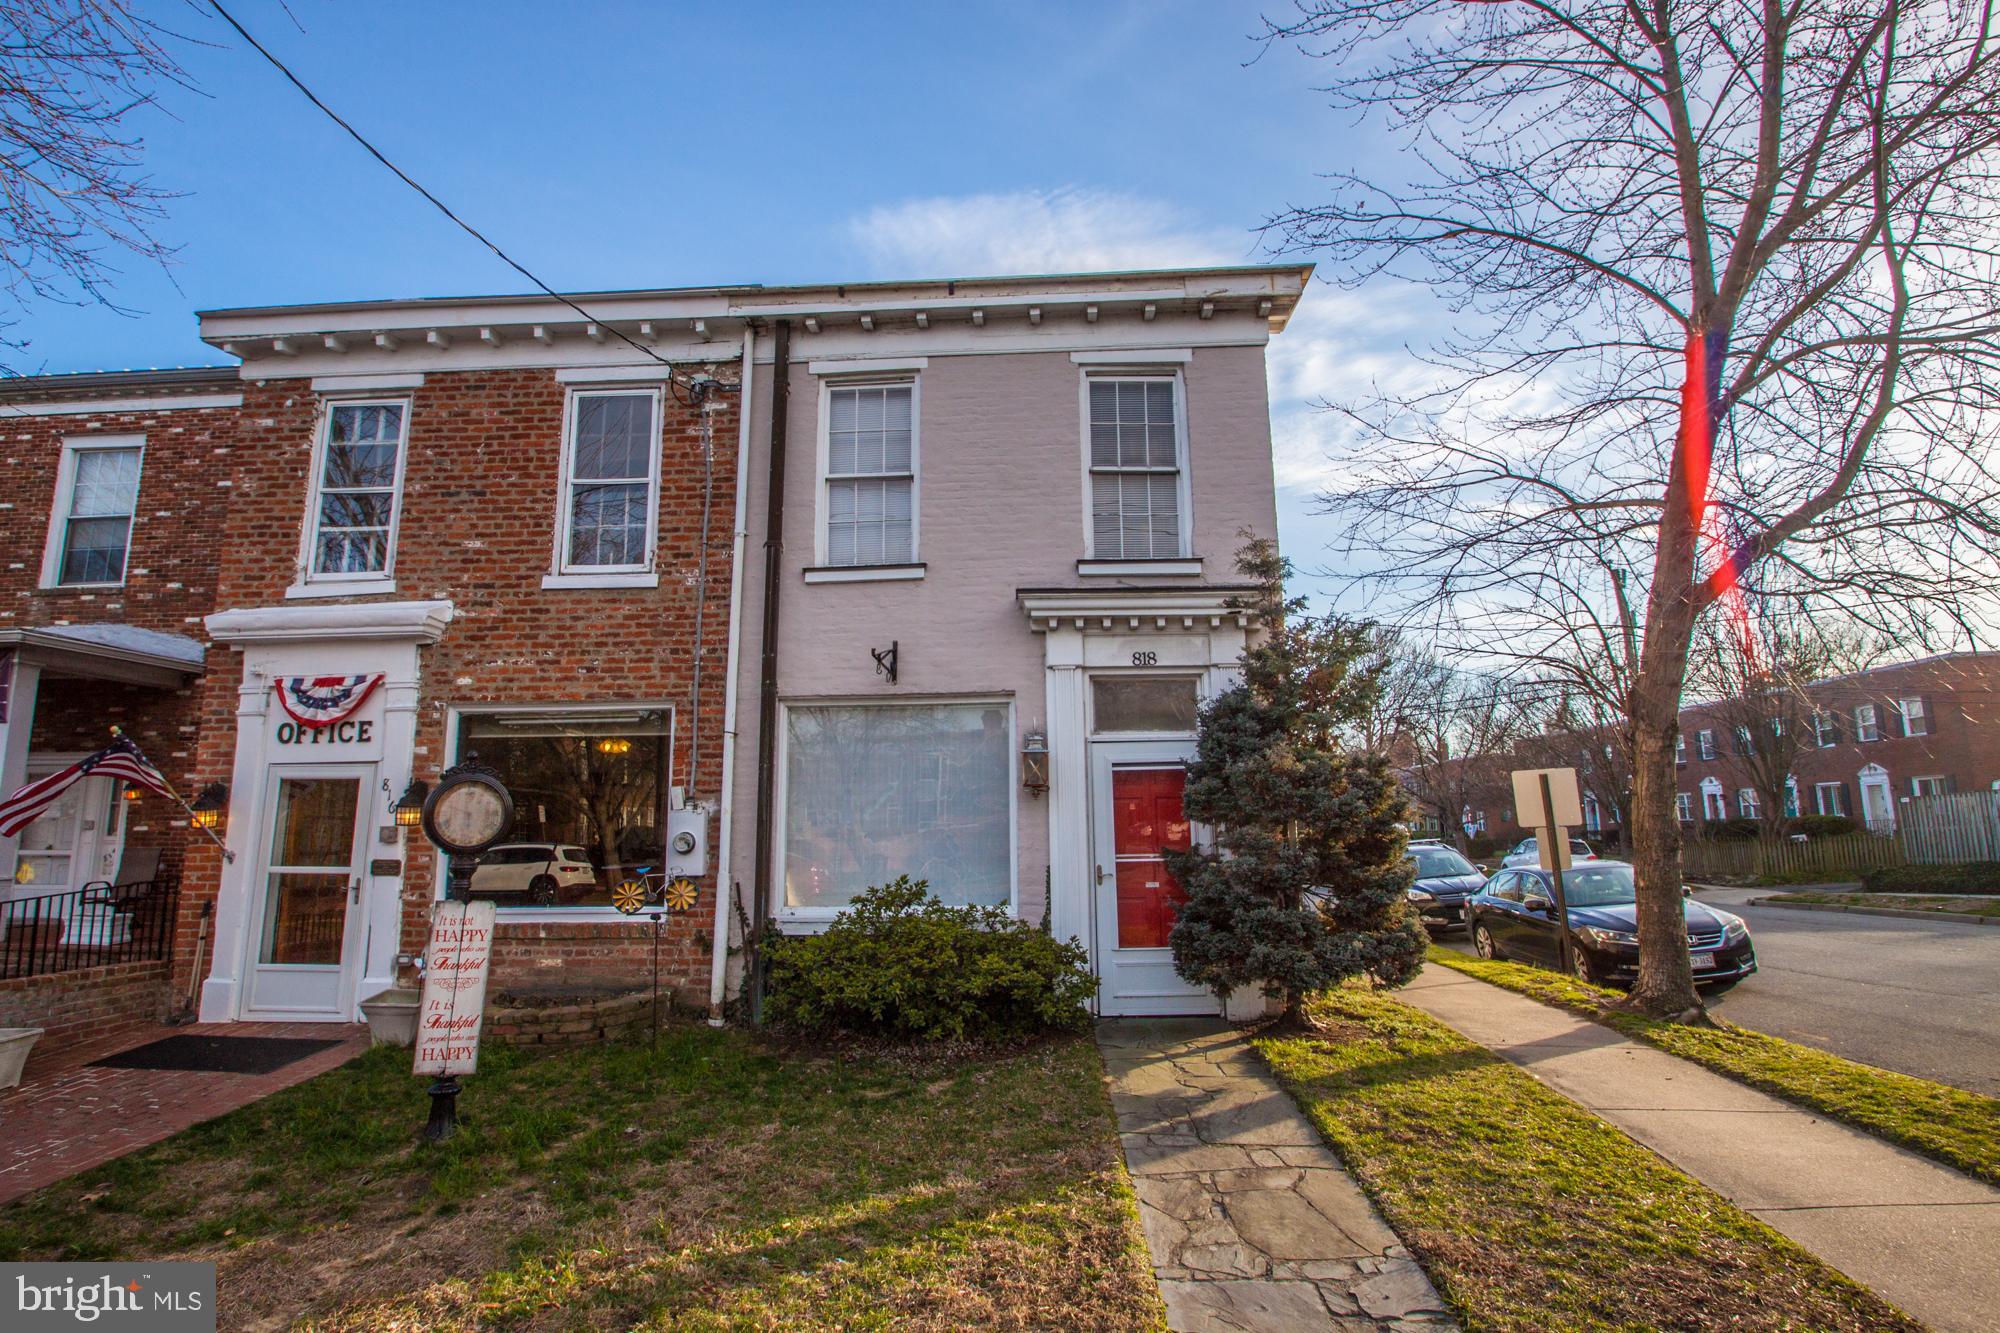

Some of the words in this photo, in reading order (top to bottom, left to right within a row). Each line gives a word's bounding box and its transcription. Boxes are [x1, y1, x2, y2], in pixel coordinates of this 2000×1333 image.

[1132, 651, 1157, 666] 818
[277, 721, 373, 744] OFFICE
[383, 778, 397, 814] 816
[439, 915, 447, 926] It
[449, 915, 457, 926] is
[459, 917, 474, 926] not
[435, 929, 489, 942] HAPPY
[432, 945, 458, 955] people
[430, 957, 486, 973] Thankful
[429, 1000, 440, 1010] It
[444, 999, 455, 1010] is
[423, 1014, 480, 1032] Thankful
[424, 1034, 449, 1044] people
[422, 1047, 476, 1061] HAPPY
